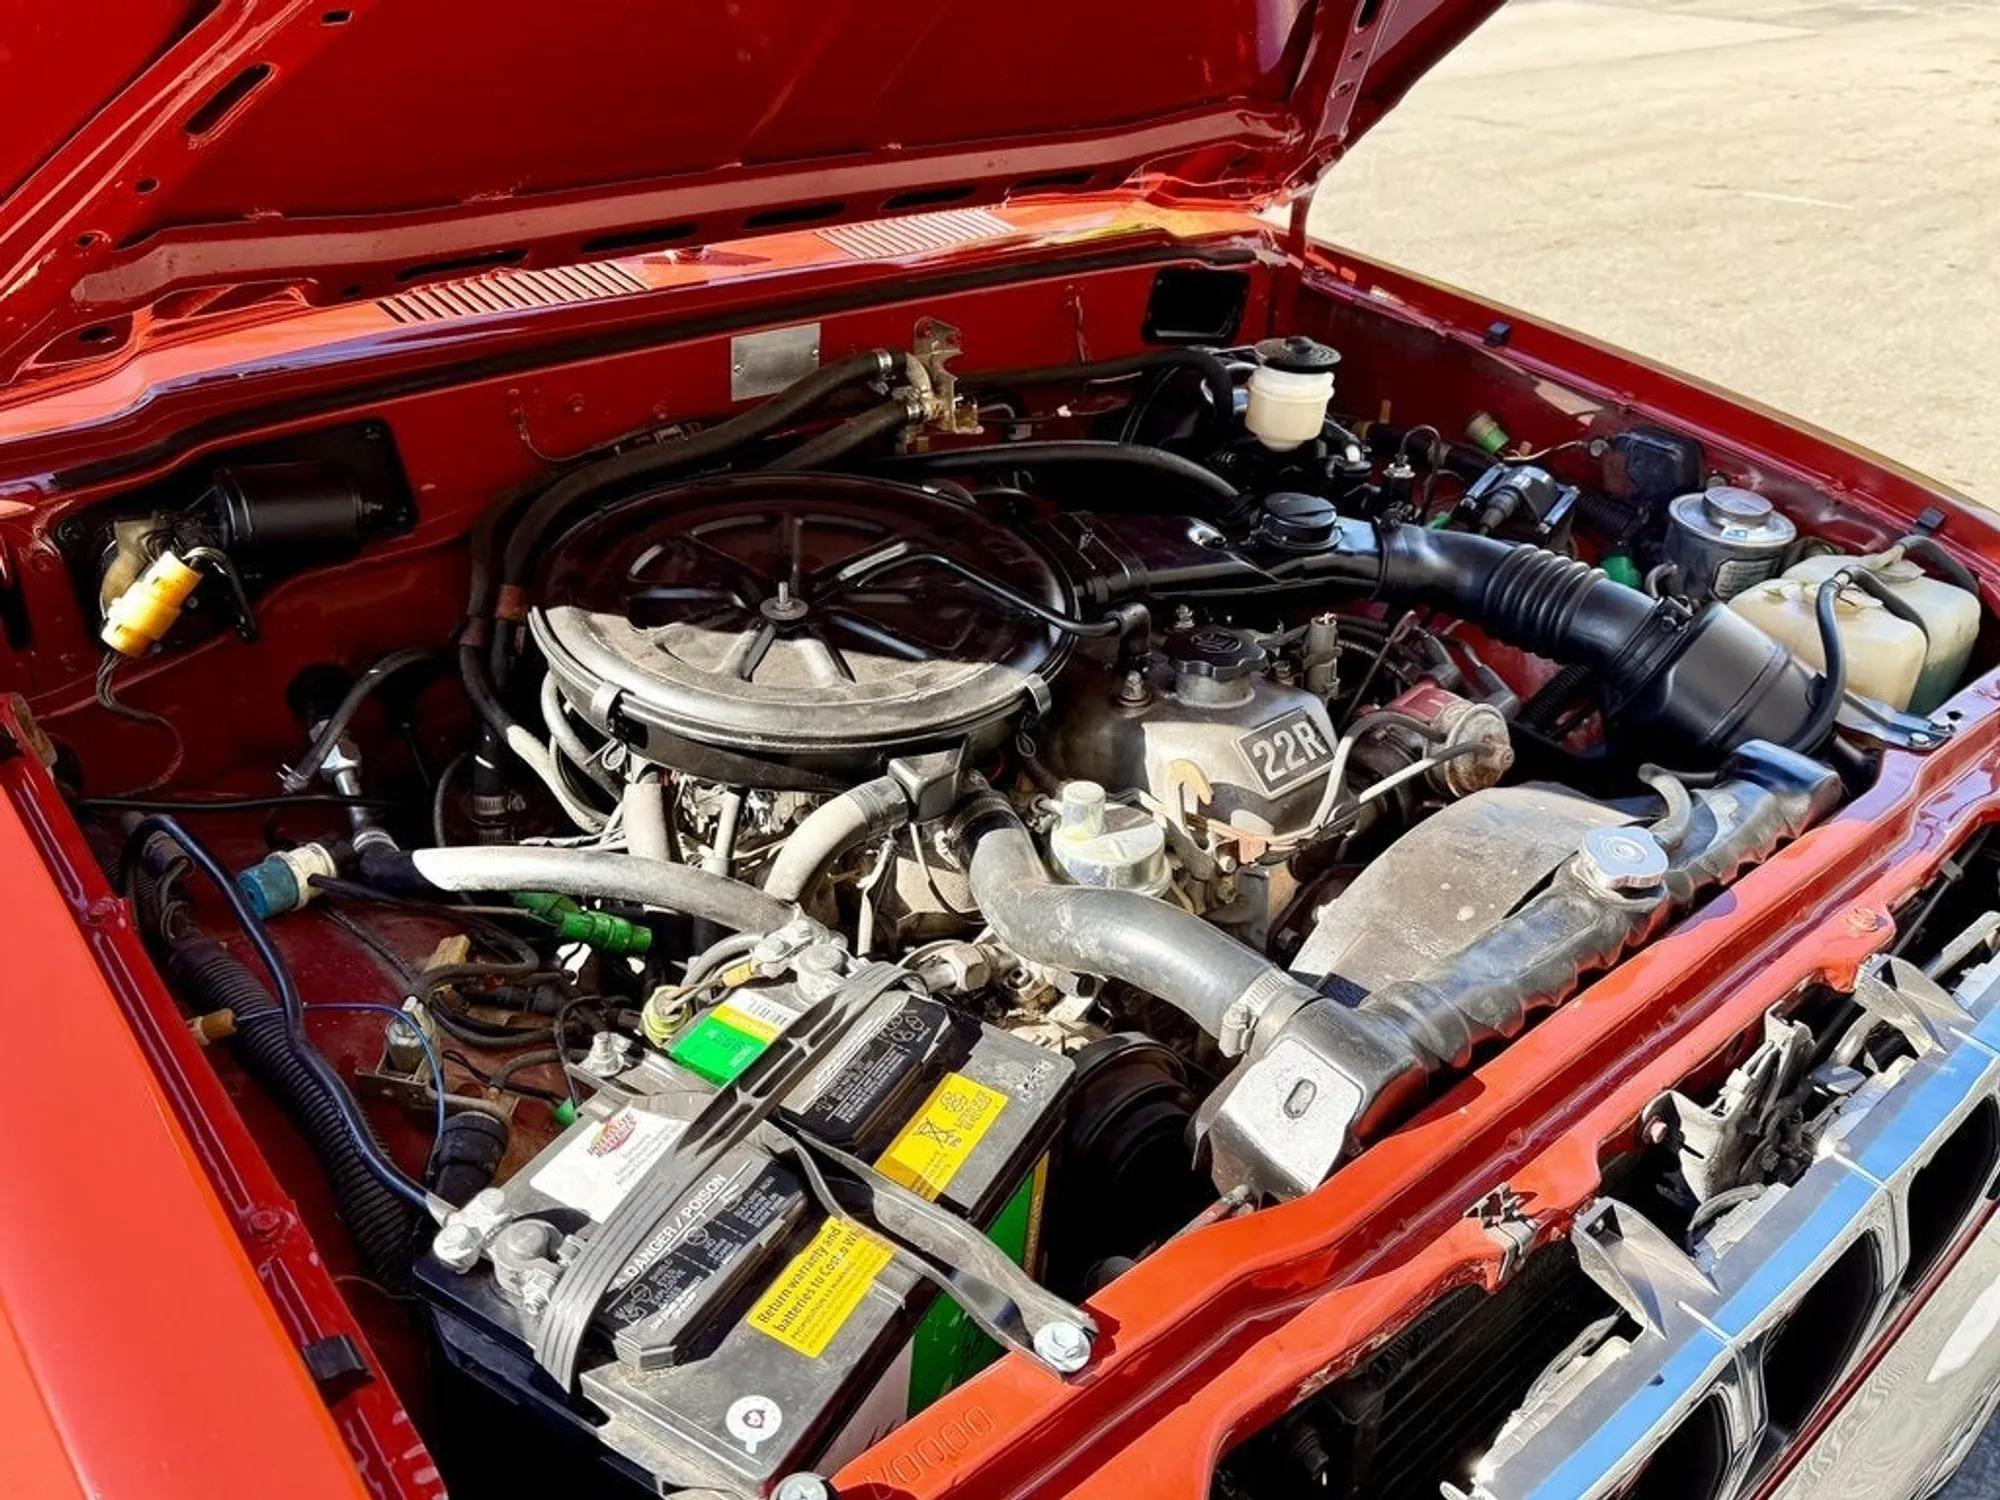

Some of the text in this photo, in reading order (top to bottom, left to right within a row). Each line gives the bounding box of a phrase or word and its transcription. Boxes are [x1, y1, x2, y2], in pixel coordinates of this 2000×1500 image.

[1252, 721, 1327, 782] 22R
[623, 1223, 677, 1278] DANGER
[680, 1172, 727, 1220] POISON
[757, 1225, 841, 1325] Return warranty and
[773, 1284, 816, 1334] batteries
[810, 1273, 825, 1289] to
